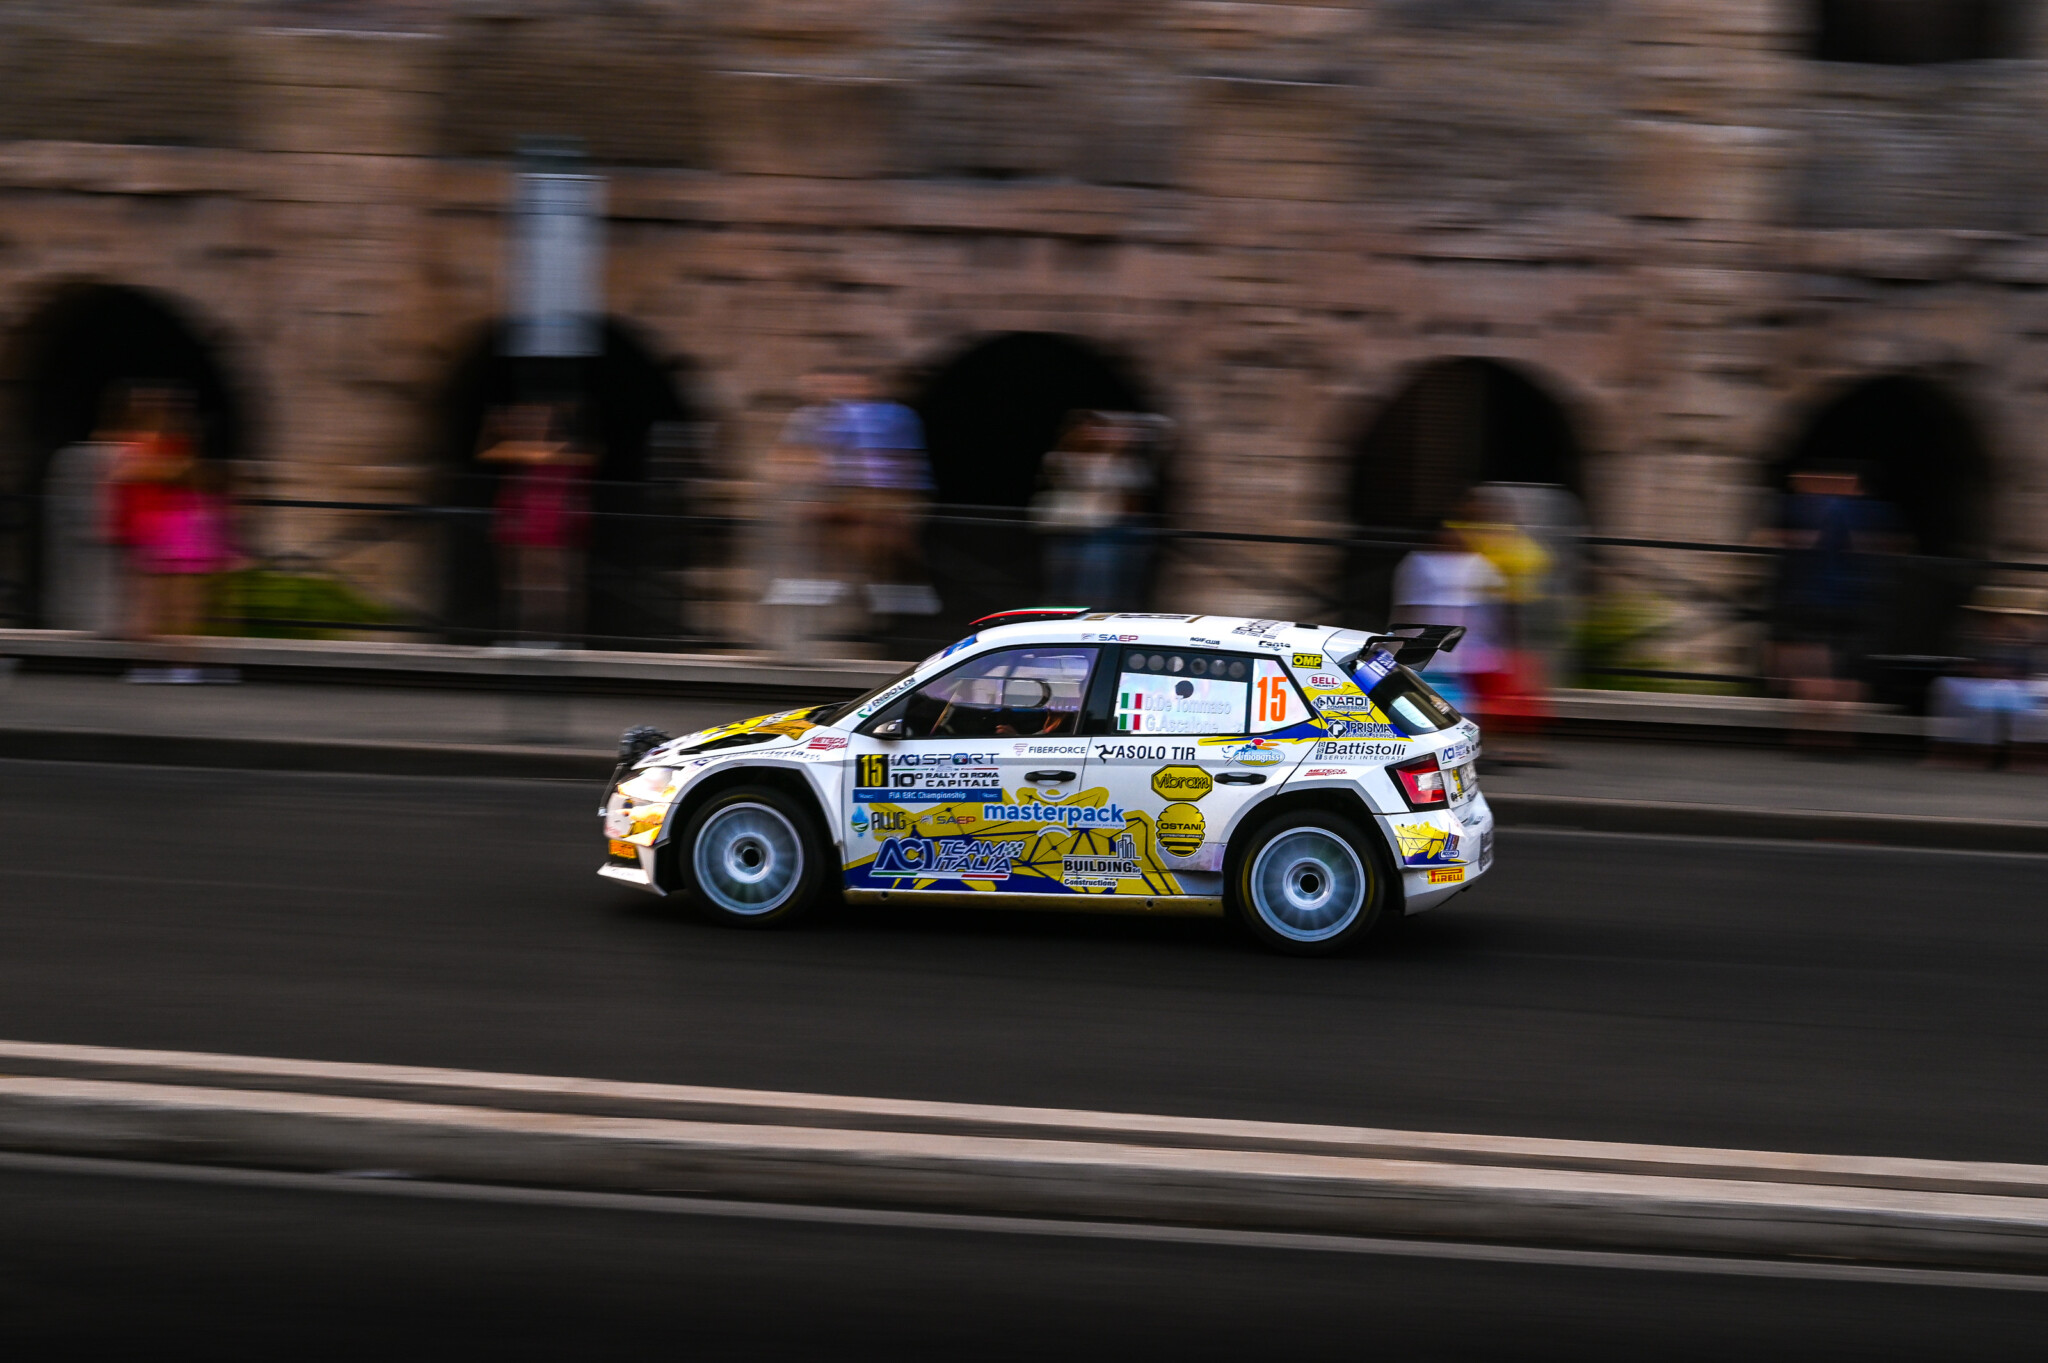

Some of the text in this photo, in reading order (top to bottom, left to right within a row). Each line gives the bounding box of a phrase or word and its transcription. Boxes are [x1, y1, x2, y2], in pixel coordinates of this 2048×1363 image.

[1098, 634, 1138, 642] SAEP
[1293, 655, 1321, 667] OMP
[1311, 676, 1339, 685] BELL
[1176, 695, 1232, 715] Tommaso
[1257, 676, 1287, 721] 15
[1326, 696, 1367, 706] NARDI
[1350, 722, 1393, 734] PRISMA
[1028, 746, 1086, 754] FIBERFORCE
[1115, 745, 1196, 761] ASOLO TIR
[1325, 741, 1407, 756] Battistolli
[922, 753, 1000, 766] SPORT
[861, 755, 884, 787] 15
[925, 779, 1000, 788] CAPITALE
[1154, 773, 1210, 789] vibram
[918, 791, 967, 800] Championship
[937, 815, 976, 825] SAEP
[984, 801, 1125, 826] masterpack
[871, 811, 907, 831] AWG
[1160, 822, 1202, 831] OSTANI
[873, 836, 936, 871] ACI
[939, 839, 1006, 858] TEAM
[934, 856, 1012, 873] ITALIA
[1064, 859, 1132, 873] BUILDING
[1063, 877, 1117, 887] Constructions
[1431, 868, 1463, 882] PIRELLI
